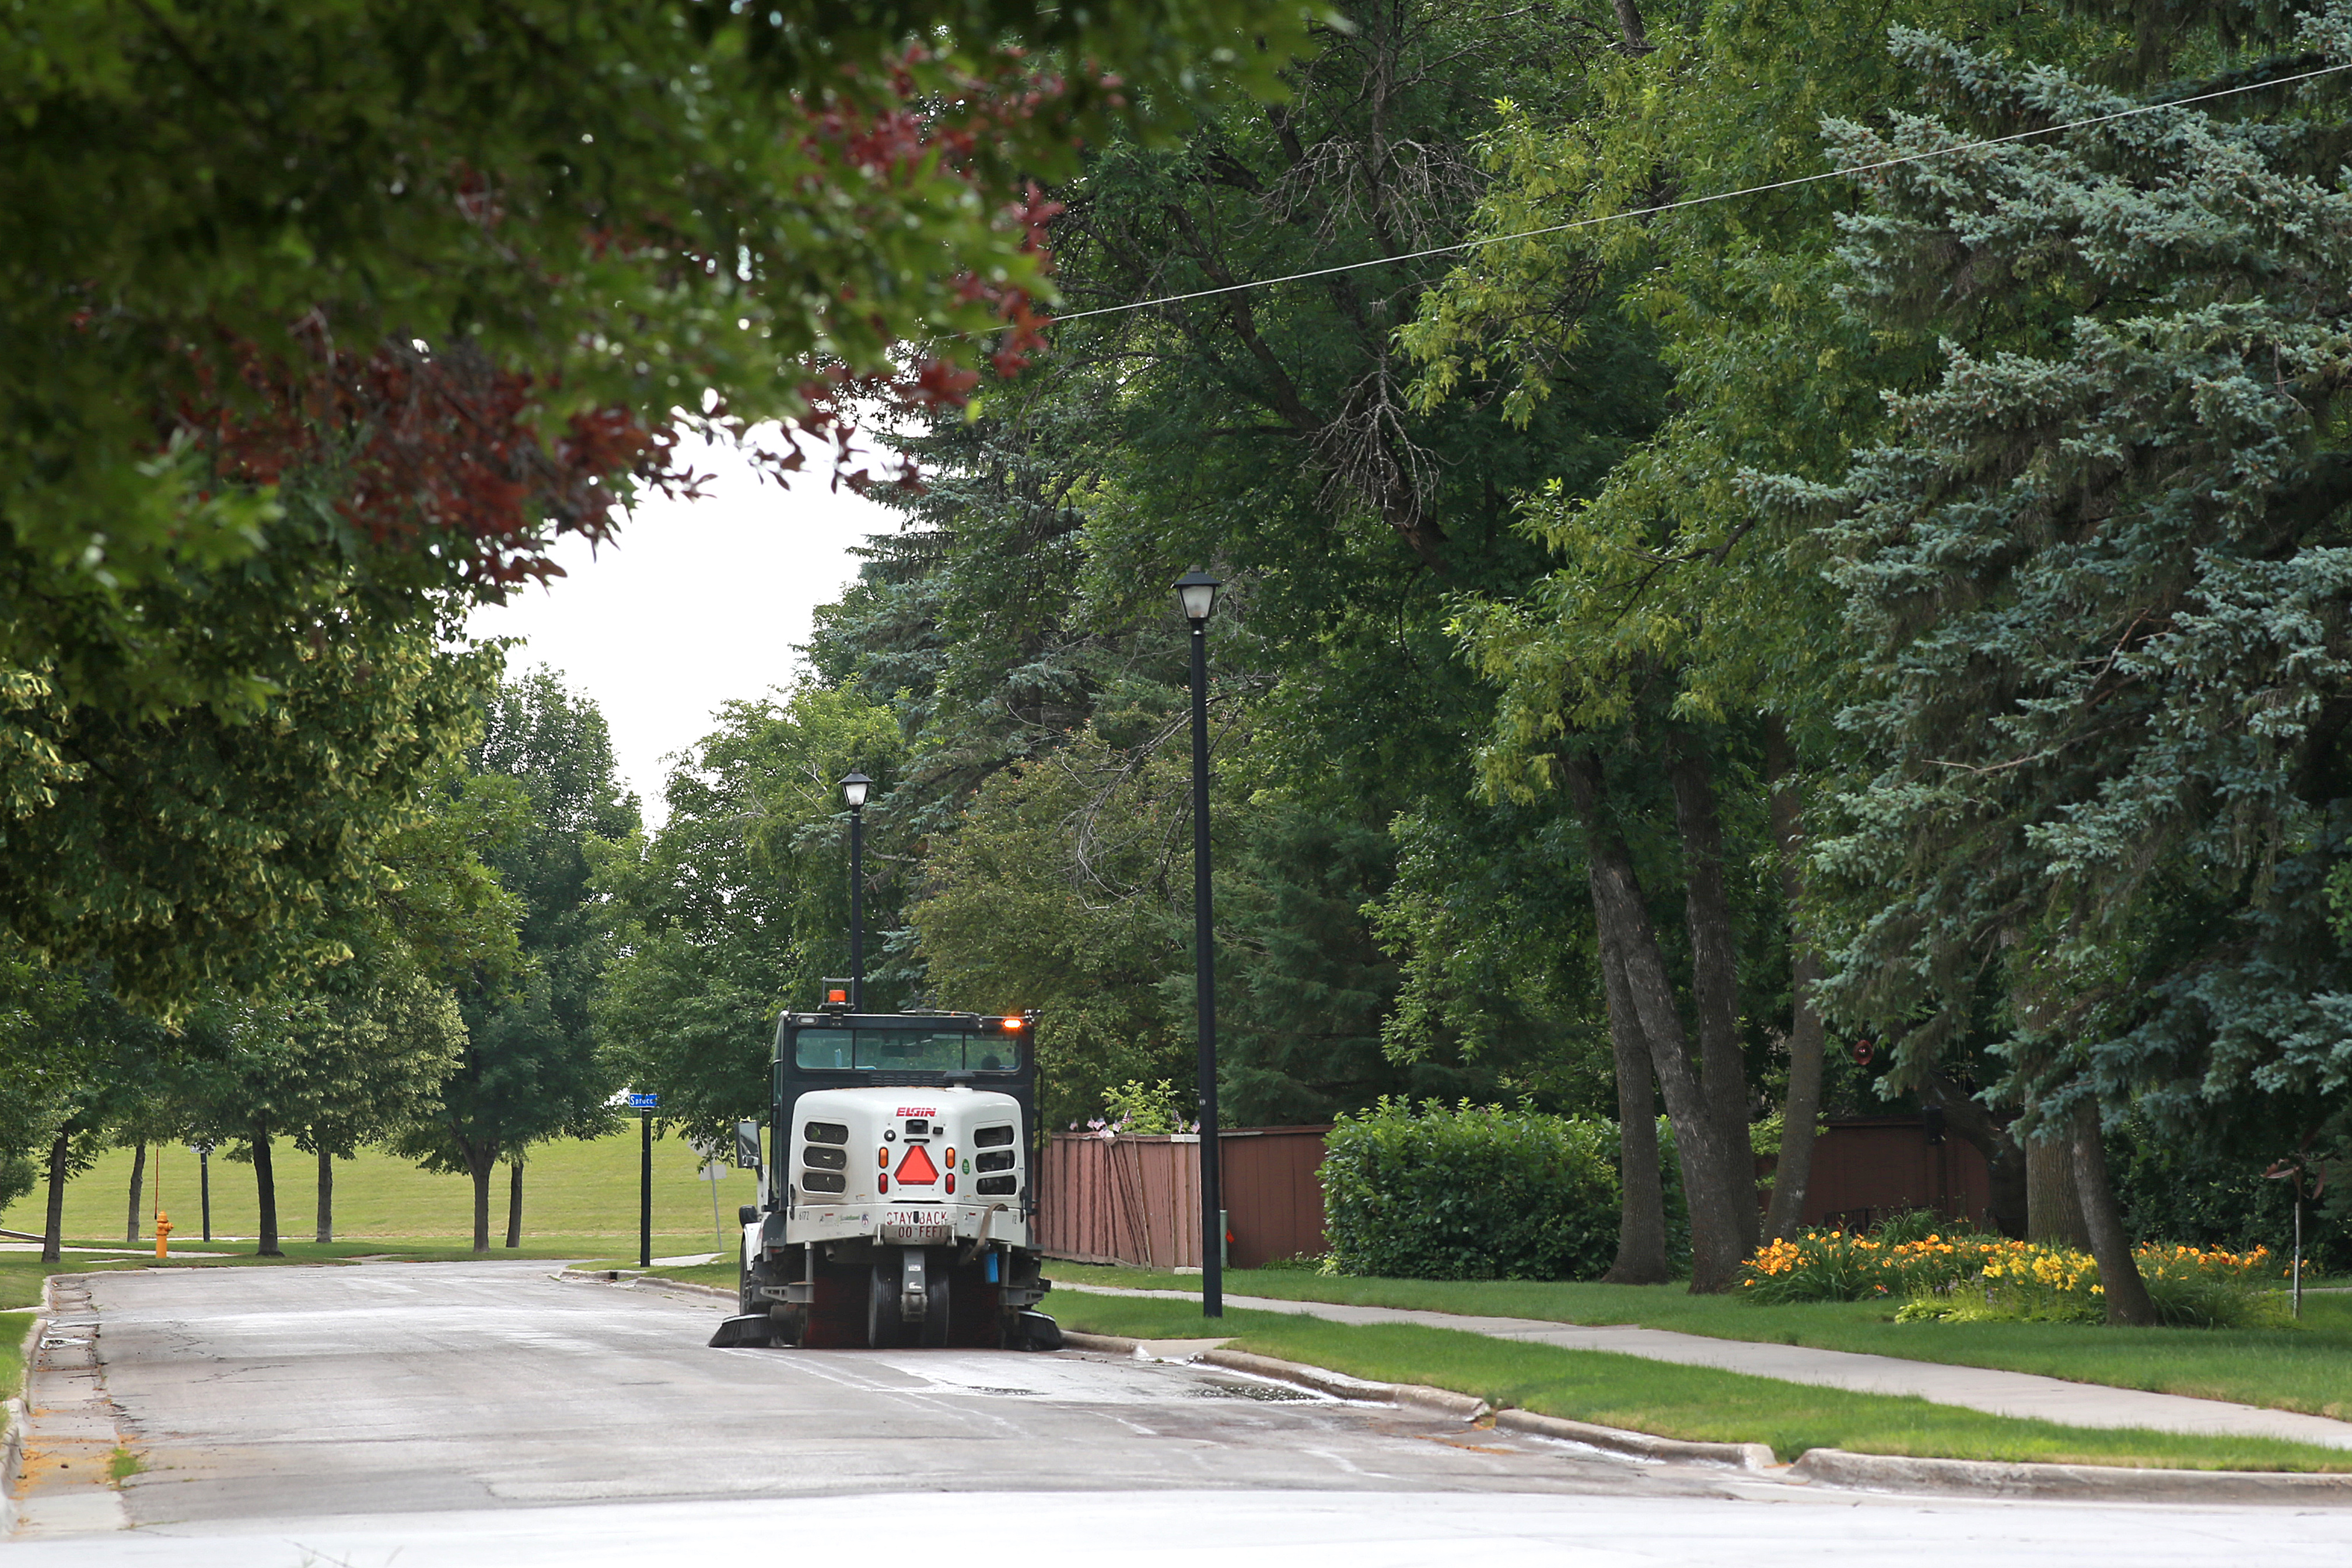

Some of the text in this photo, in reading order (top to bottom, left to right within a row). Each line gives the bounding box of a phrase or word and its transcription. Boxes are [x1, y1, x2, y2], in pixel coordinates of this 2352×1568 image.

[630, 1096, 653, 1105] Spruce
[896, 1107, 936, 1117] ELGIN
[887, 1211, 947, 1225] STAY BACK
